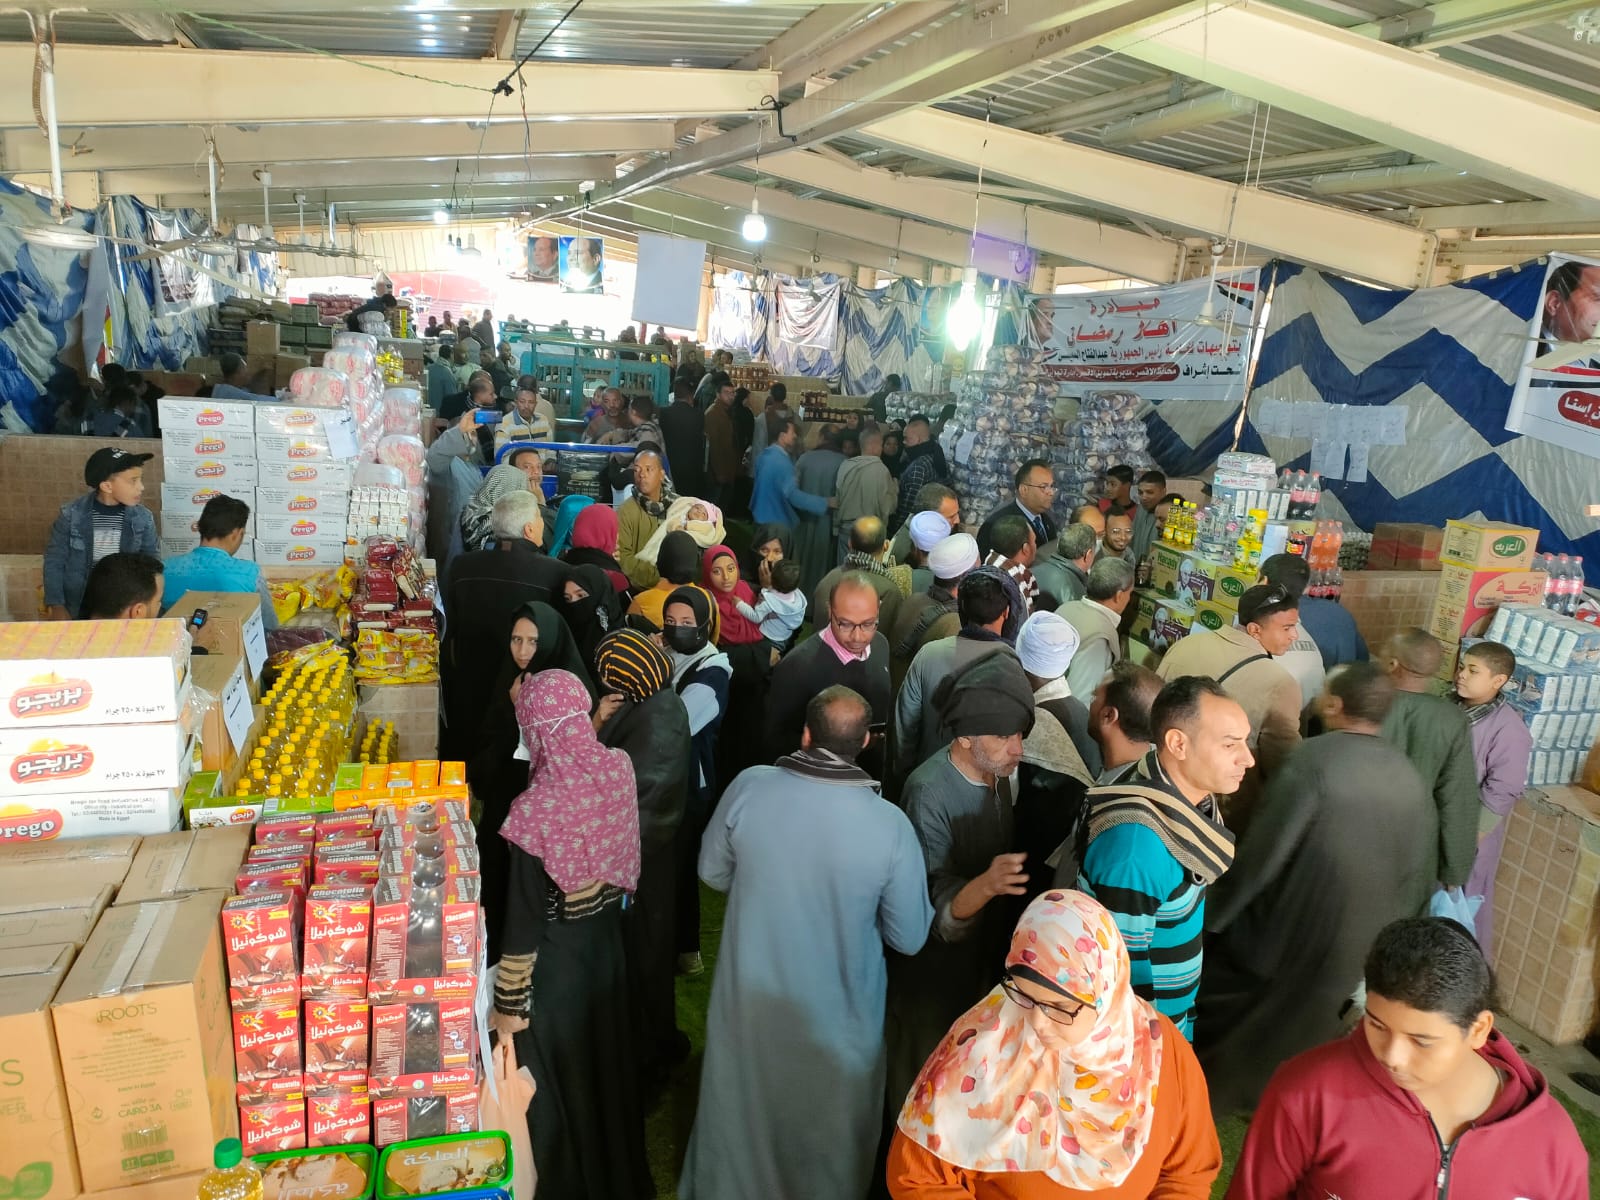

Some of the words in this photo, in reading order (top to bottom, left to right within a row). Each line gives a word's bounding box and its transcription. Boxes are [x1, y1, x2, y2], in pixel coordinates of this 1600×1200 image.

[1085, 297, 1160, 318] مبادرة
[1066, 323, 1124, 348] رمضان
[16, 687, 83, 713] بريجو
[17, 752, 84, 778] بريجو
[254, 843, 304, 855] Chocotella
[318, 840, 367, 853] Chocotella
[229, 893, 284, 907] Chocotella
[312, 887, 366, 898] Chocotella
[231, 927, 287, 951] شوكوتيلا
[311, 921, 365, 940] شوكوتيلا
[240, 1025, 294, 1048] شوكوتيلا
[311, 1019, 364, 1040] شوكوتيلا
[247, 1119, 301, 1144] شوكوتيلا
[313, 1111, 366, 1134] شوكوتيلا
[403, 1147, 469, 1166] الملكة
